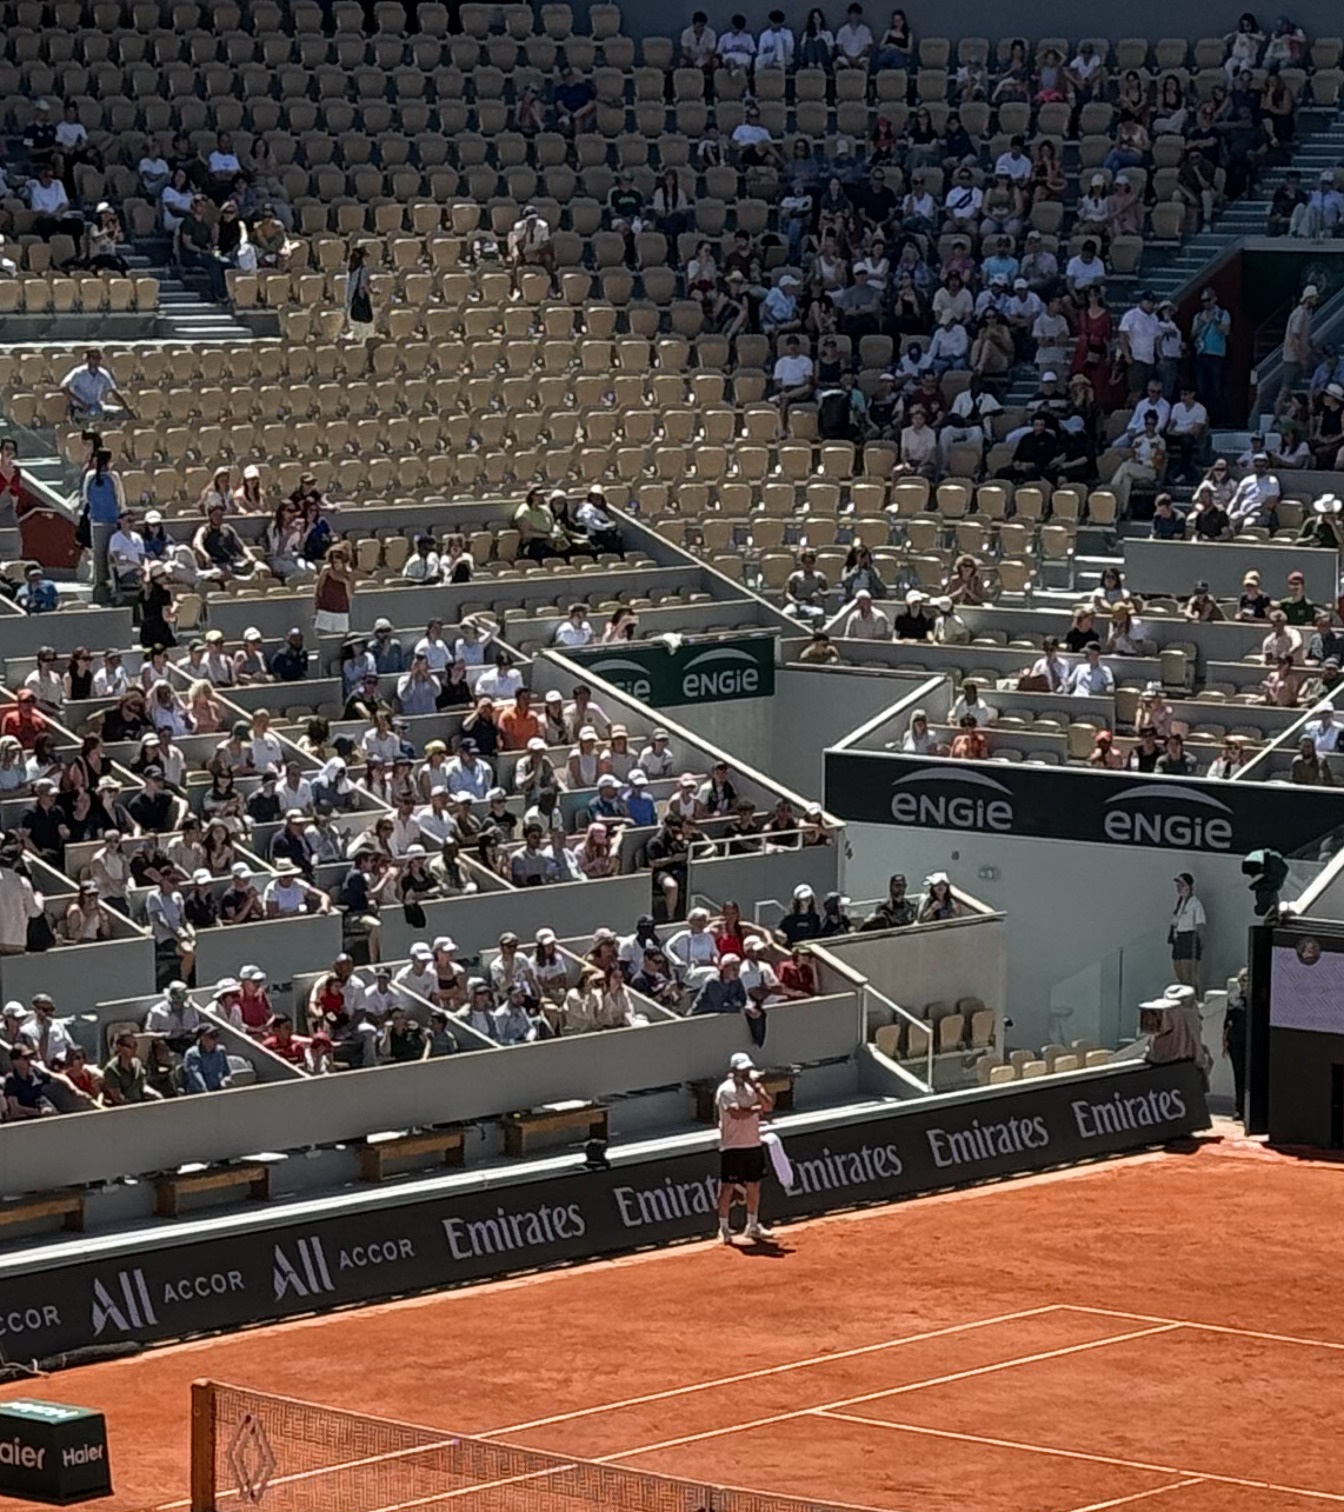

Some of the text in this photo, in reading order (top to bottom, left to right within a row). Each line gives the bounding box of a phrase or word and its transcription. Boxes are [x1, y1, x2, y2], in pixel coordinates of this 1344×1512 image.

[1070, 1084, 1188, 1140] Emirates
[926, 1111, 1050, 1170] Emirates
[442, 1199, 586, 1261] Emirates
[338, 1237, 416, 1270] ACCOR
[163, 1269, 246, 1304] ACCOR
[62, 1442, 104, 1468] Haier
